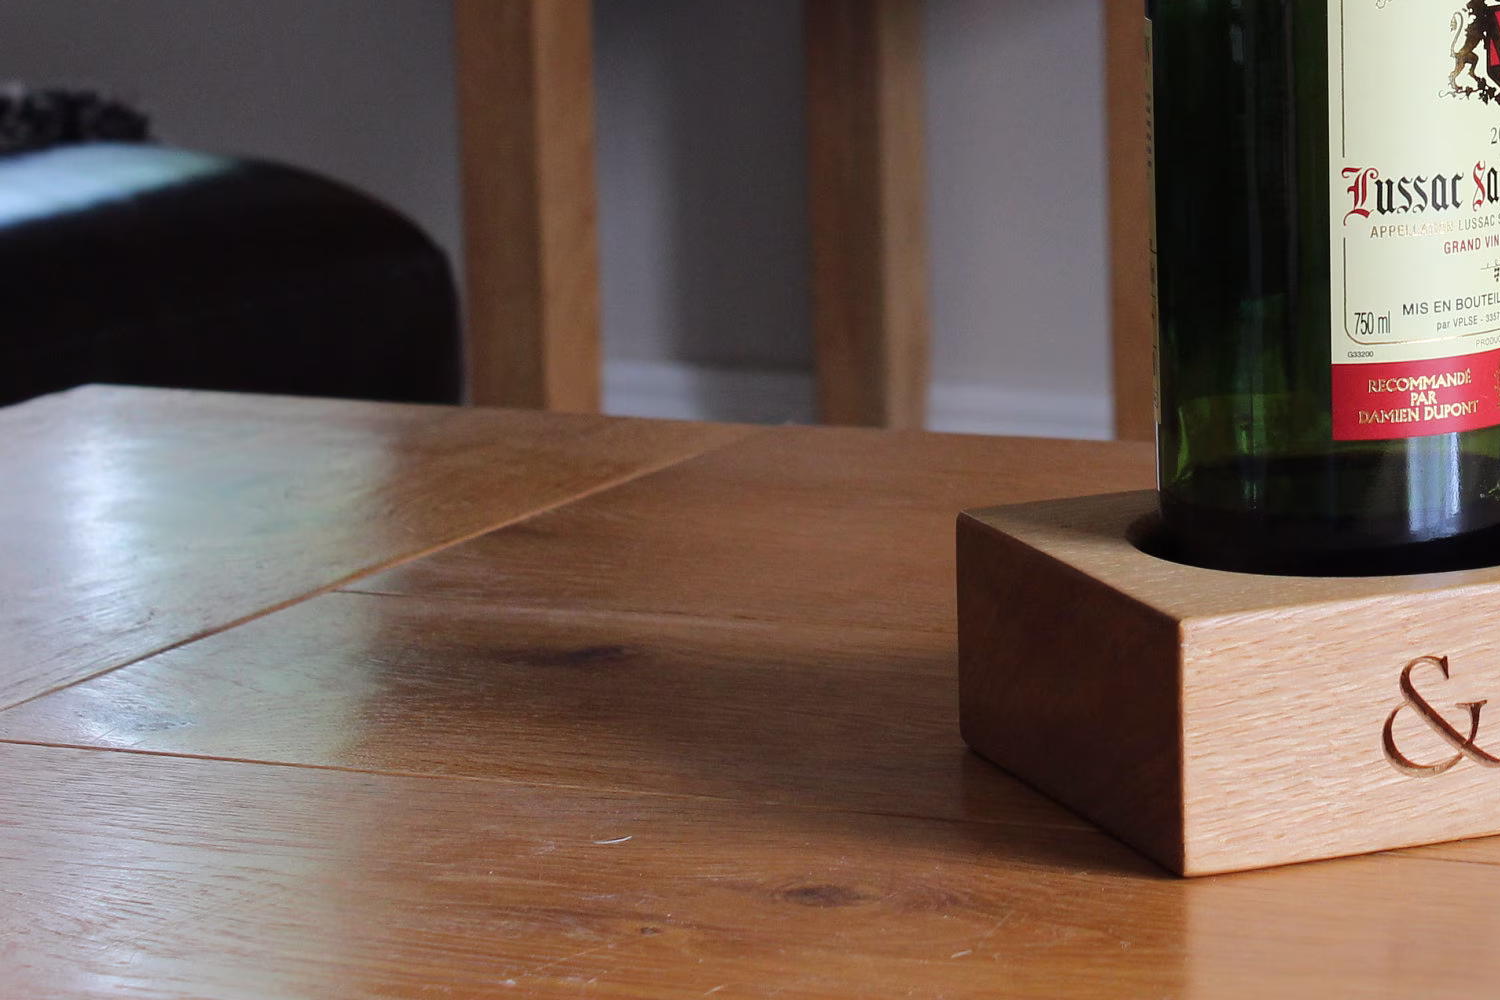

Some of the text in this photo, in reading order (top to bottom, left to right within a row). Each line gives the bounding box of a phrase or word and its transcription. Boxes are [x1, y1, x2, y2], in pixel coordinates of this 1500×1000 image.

[1341, 167, 1464, 226] Lussac
[1458, 215, 1495, 231] LUSSAC
[1444, 237, 1481, 254] GRAND
[1485, 234, 1500, 249] VIN
[1402, 302, 1429, 316] MIS
[1434, 299, 1451, 313] EN
[1354, 310, 1391, 335] 750 ml
[1436, 320, 1450, 332] par
[1453, 315, 1478, 328] VPLSE
[1368, 368, 1472, 393] RECOMMANDÉ
[1410, 391, 1437, 407] PAR
[1358, 400, 1479, 425] DAMIEN DUPONT
